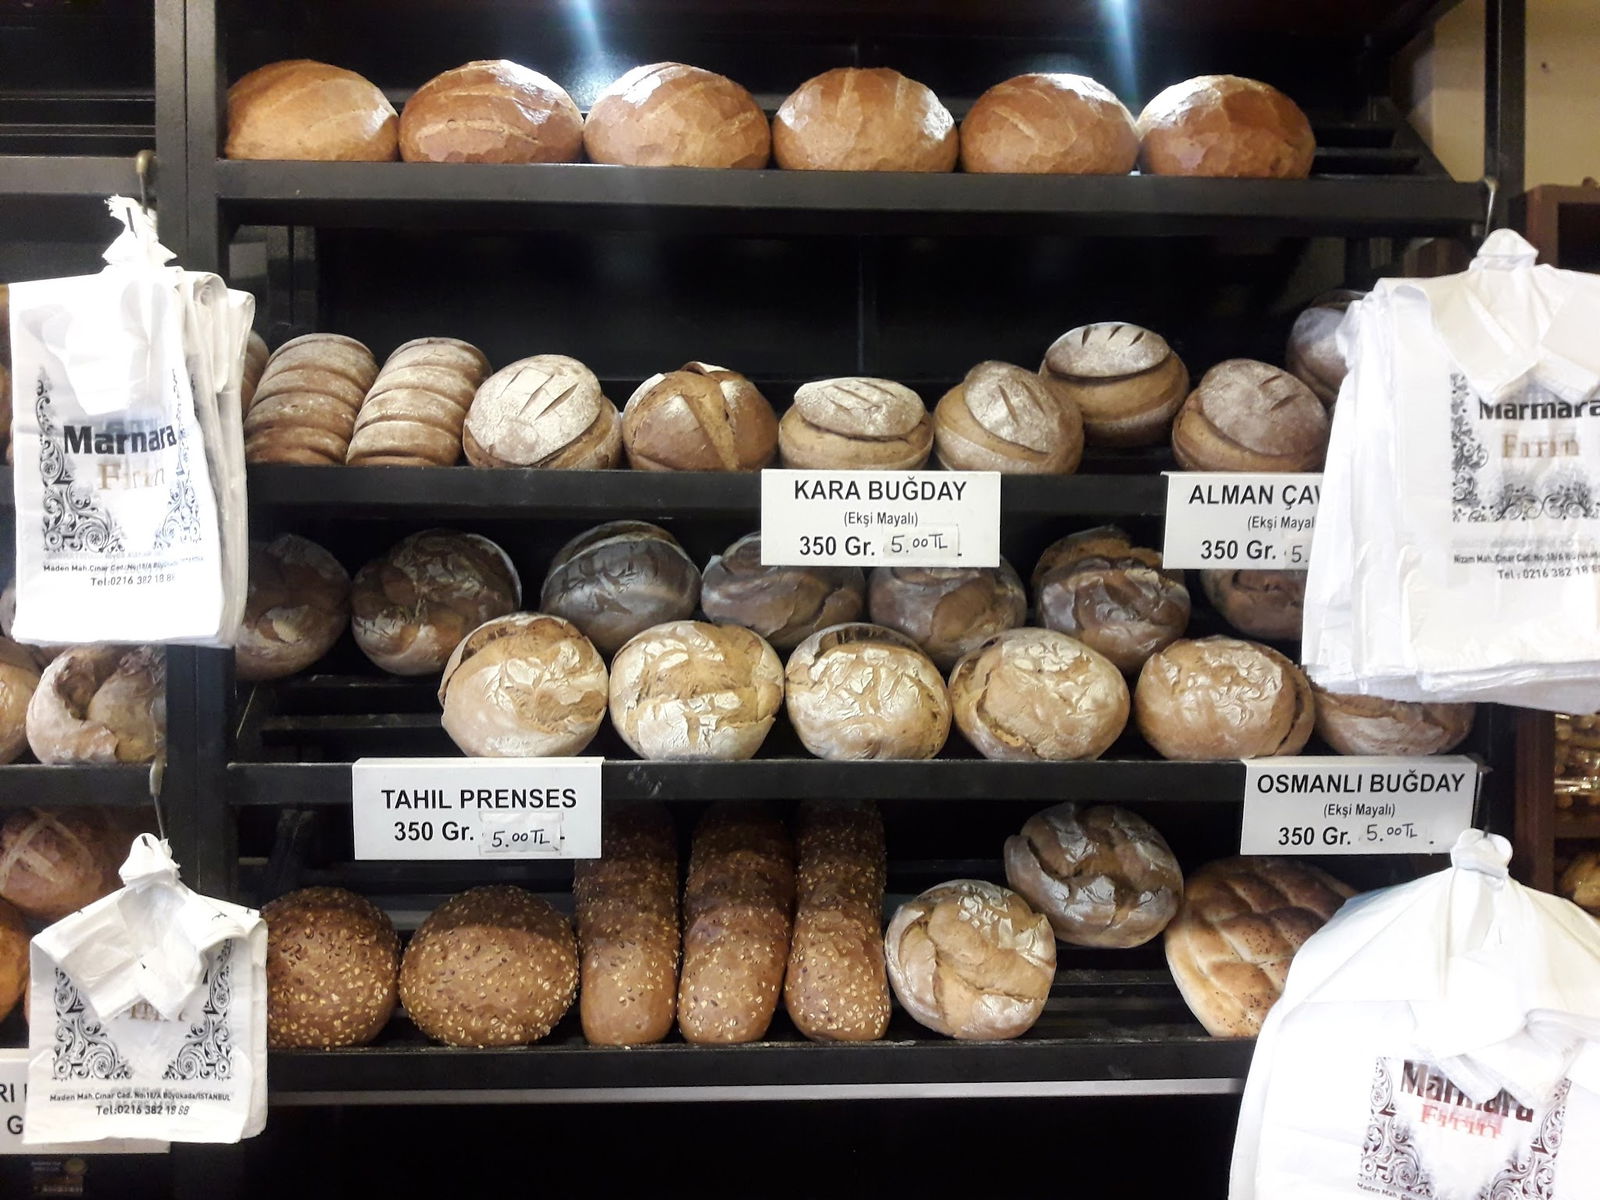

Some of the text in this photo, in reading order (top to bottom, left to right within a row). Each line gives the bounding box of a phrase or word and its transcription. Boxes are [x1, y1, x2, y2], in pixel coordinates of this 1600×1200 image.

[794, 476, 967, 501] KARA BUĞDAY
[1188, 484, 1274, 505] ALMAN
[843, 511, 919, 528] (Ekşi Mayalı)
[1247, 515, 1277, 532] (Ekşi
[799, 536, 837, 556] 350
[845, 536, 875, 556] Gr.
[1200, 540, 1238, 560] 350
[1247, 540, 1276, 560] Gr.
[1257, 769, 1466, 794] OSMANLI BUĞDAY
[381, 788, 577, 809] TAHIL PRENSES
[1323, 802, 1396, 818] (Ekşi Mayalı)
[394, 821, 434, 842] 350
[442, 821, 474, 842] Gr.
[1278, 827, 1315, 846] 350
[1322, 826, 1351, 846] Gr.
[50, 1093, 75, 1102] Maden
[144, 1104, 163, 1115] 382
